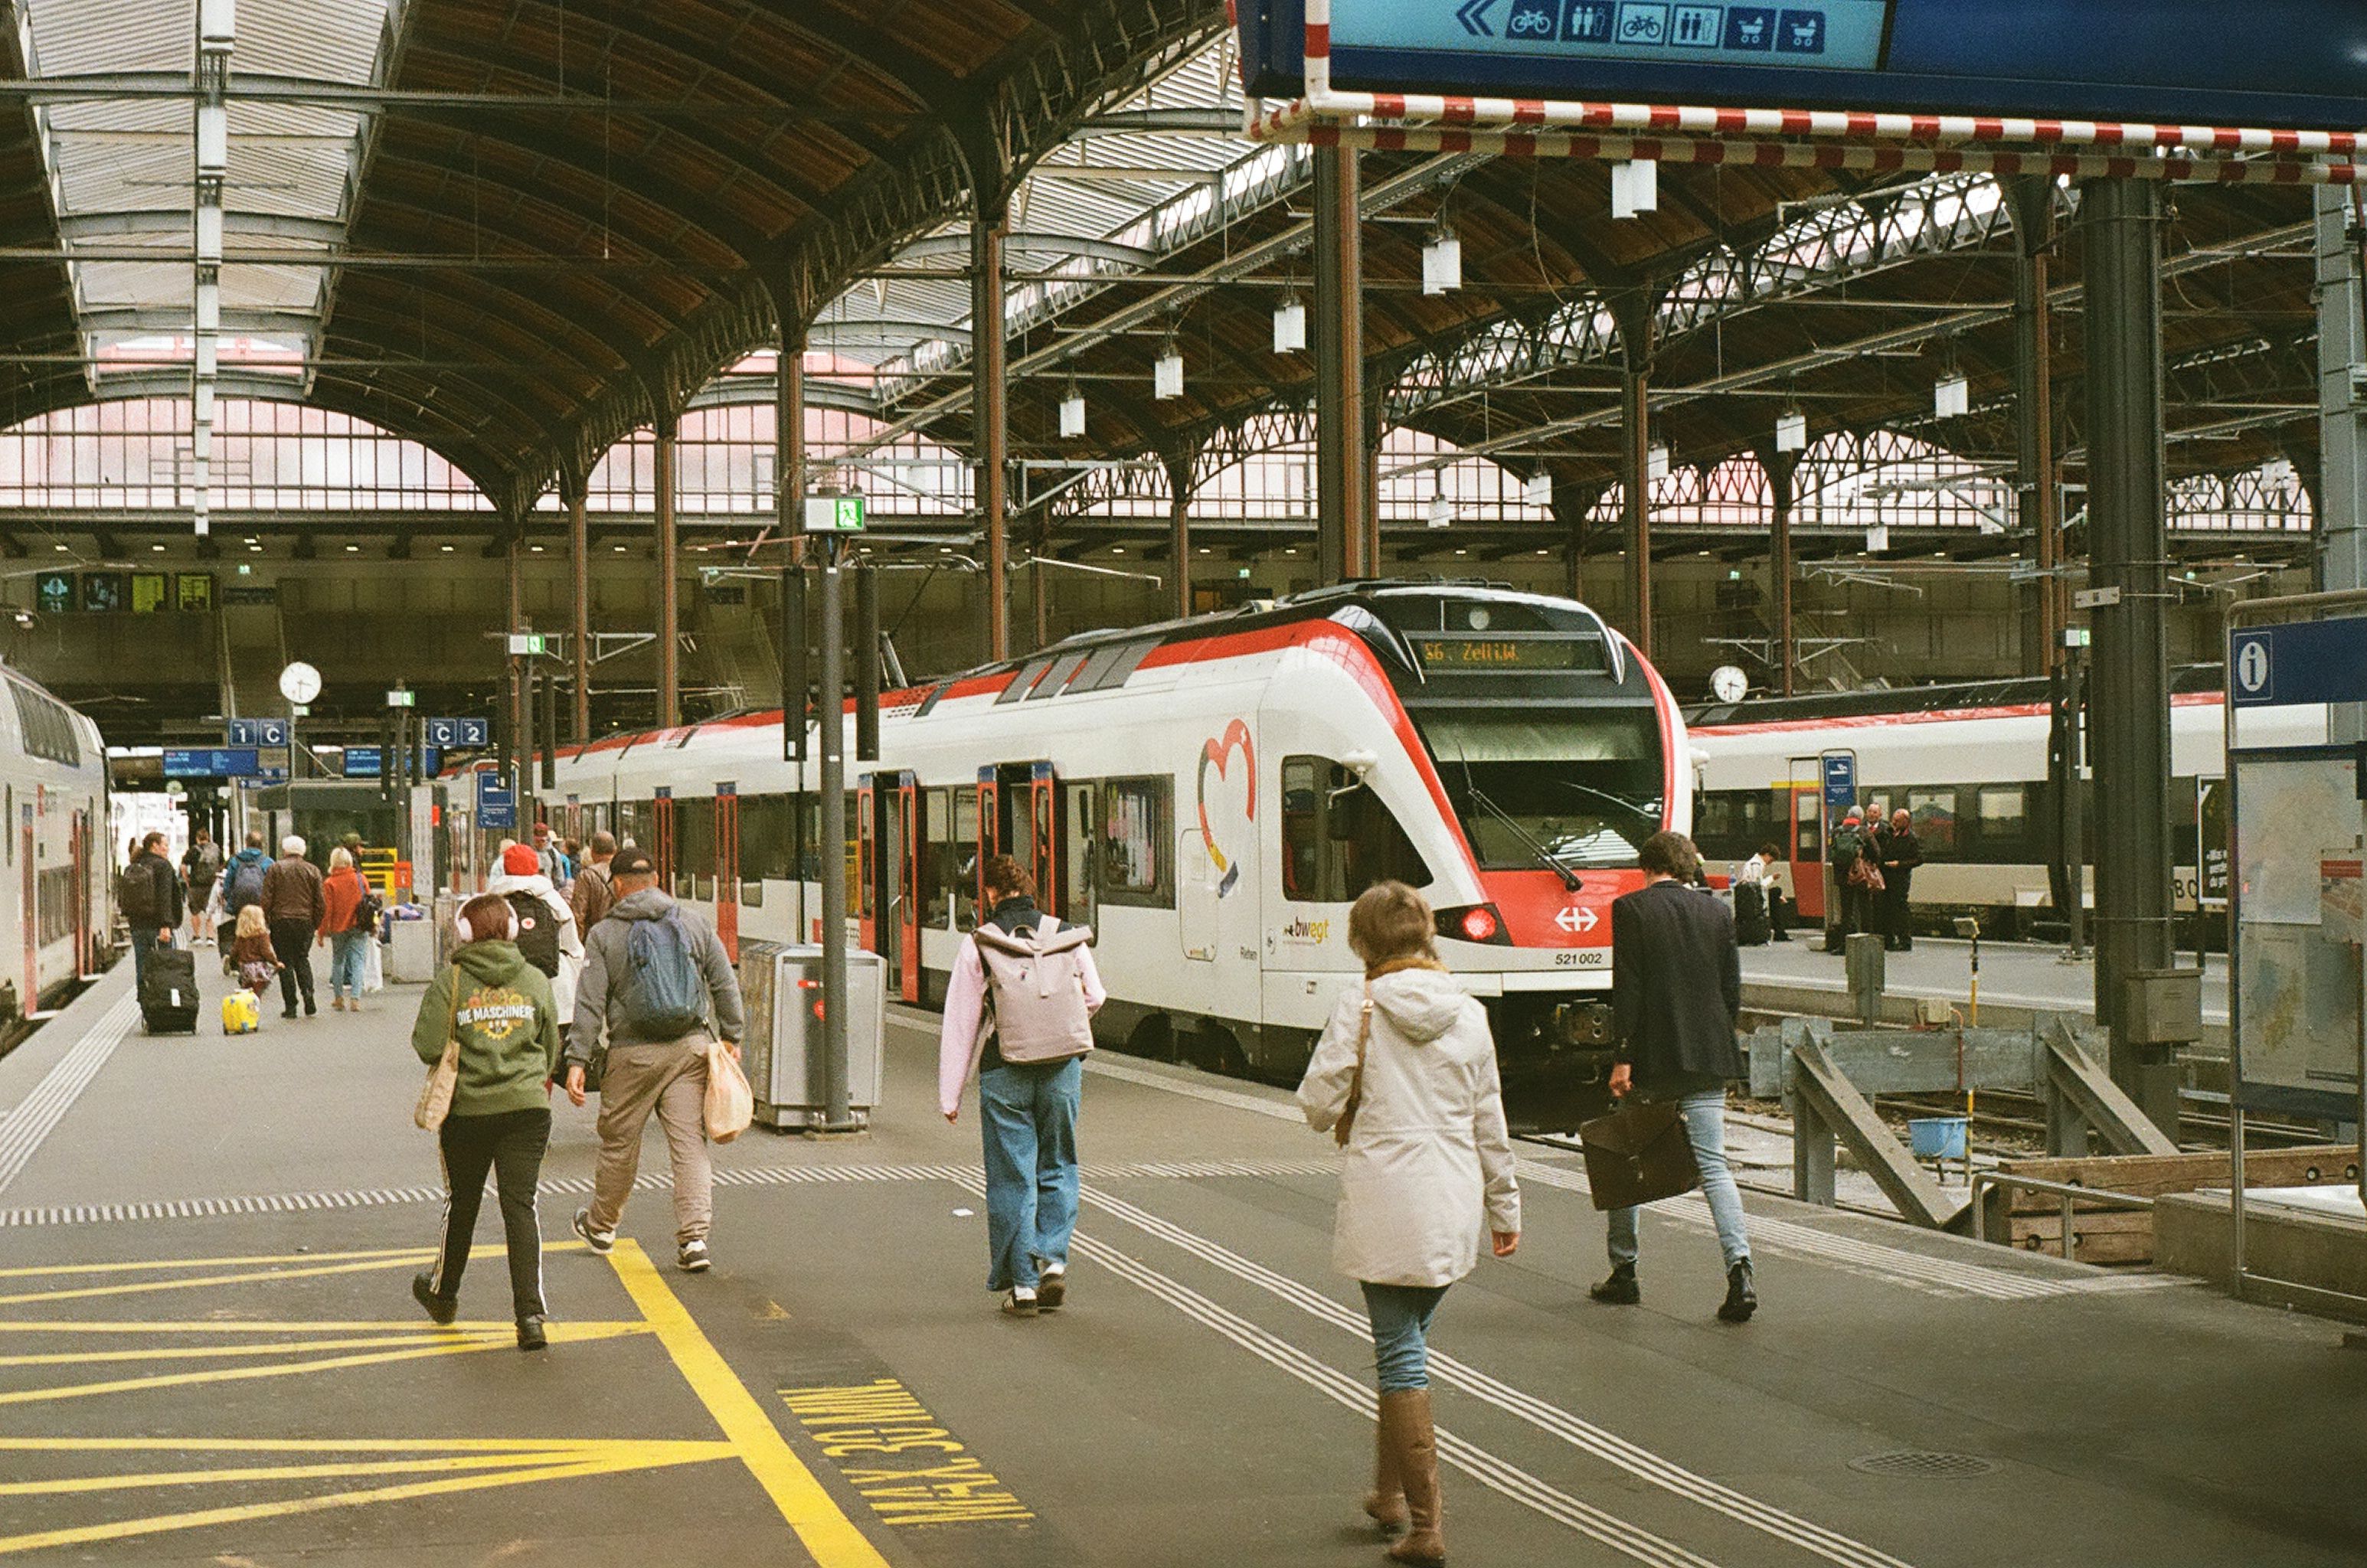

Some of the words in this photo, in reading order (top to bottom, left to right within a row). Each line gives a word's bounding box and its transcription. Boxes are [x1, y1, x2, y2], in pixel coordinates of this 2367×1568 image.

[1462, 643, 1491, 661] Zell
[238, 727, 246, 743] 1
[266, 727, 280, 743] C
[437, 726, 450, 742] C
[467, 726, 479, 741] 2
[812, 1428, 964, 1456] 30
